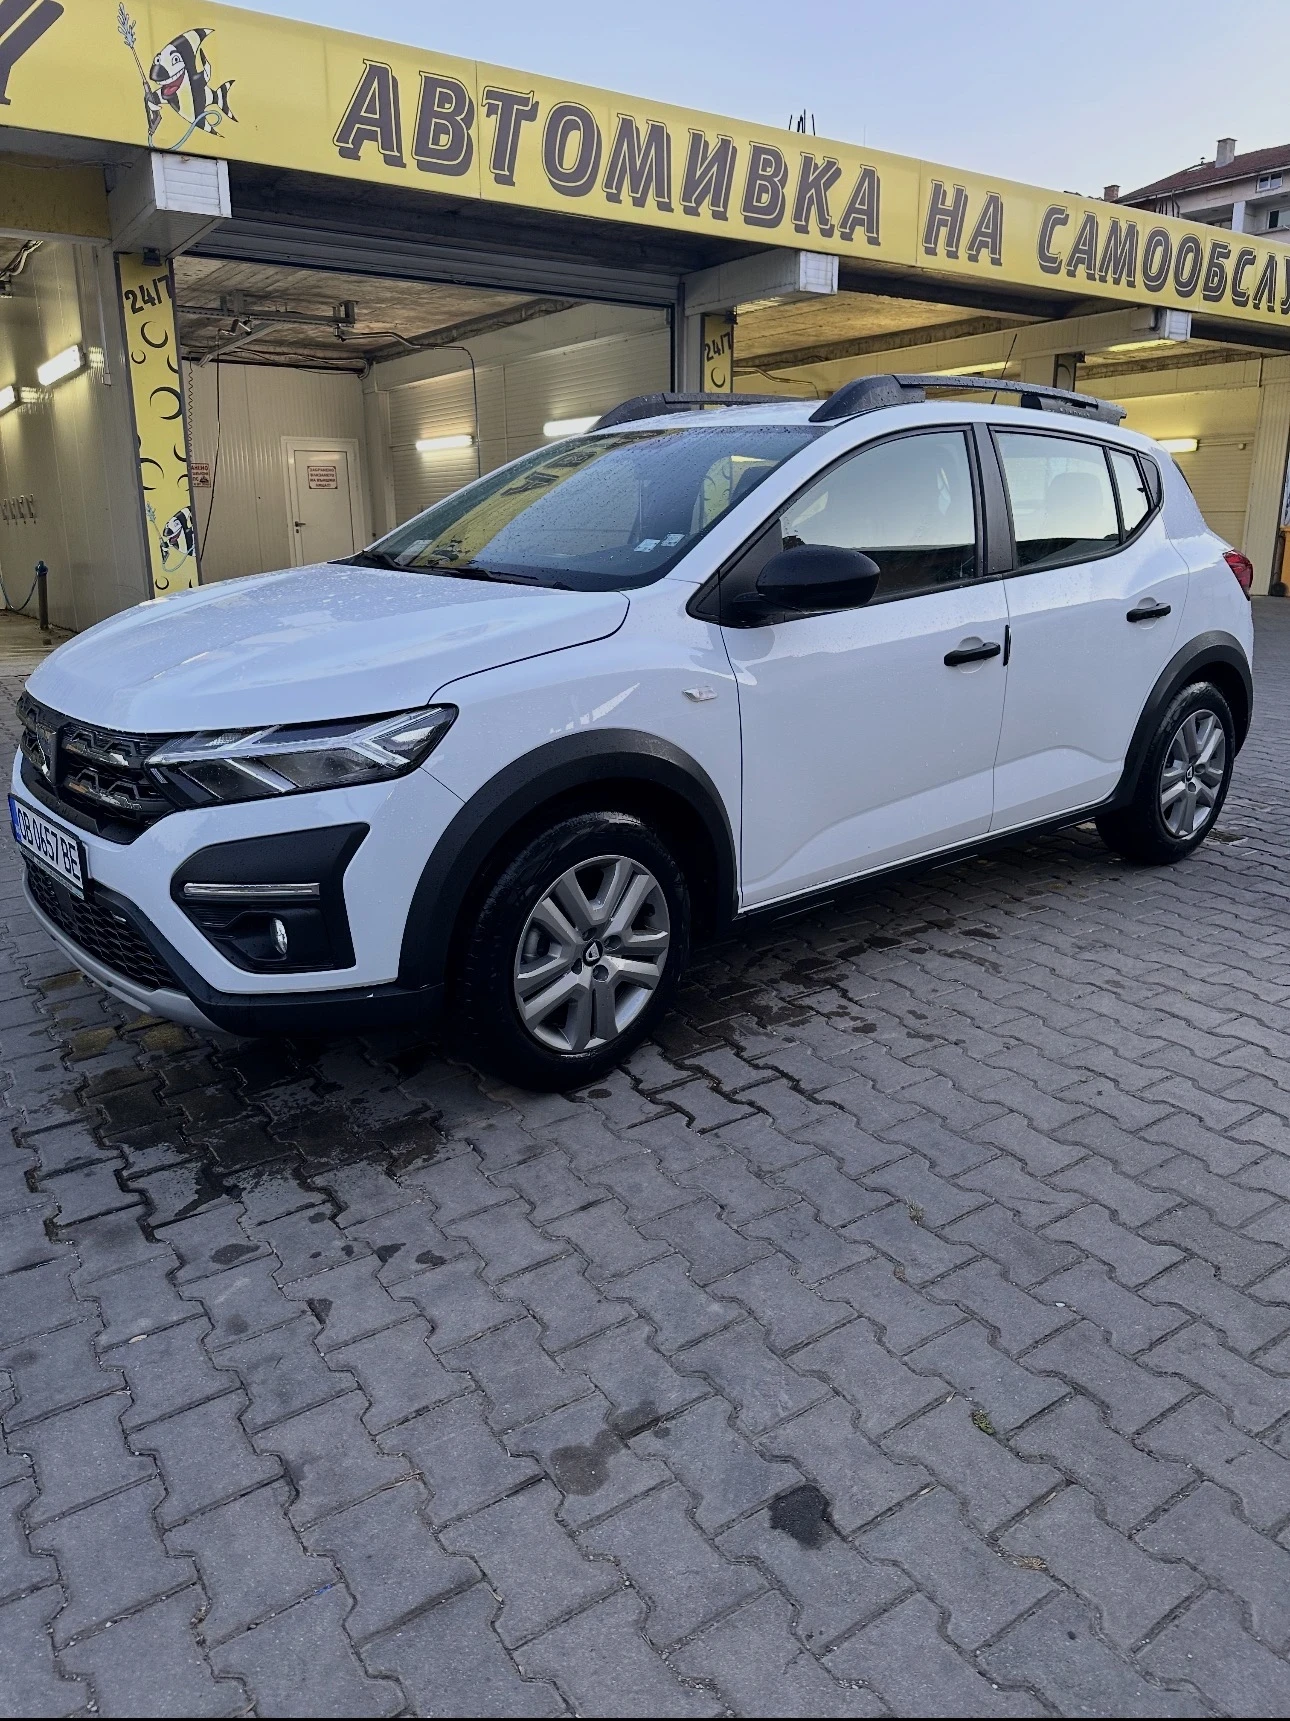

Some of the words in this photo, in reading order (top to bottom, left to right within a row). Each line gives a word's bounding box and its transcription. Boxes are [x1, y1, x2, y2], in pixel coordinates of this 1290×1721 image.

[332, 58, 881, 247] АВТОМИВКА
[922, 179, 1003, 266] НА
[124, 274, 172, 315] 24/7
[704, 331, 732, 362] 24/7
[32, 817, 59, 865] 0657
[60, 836, 81, 882] BE
